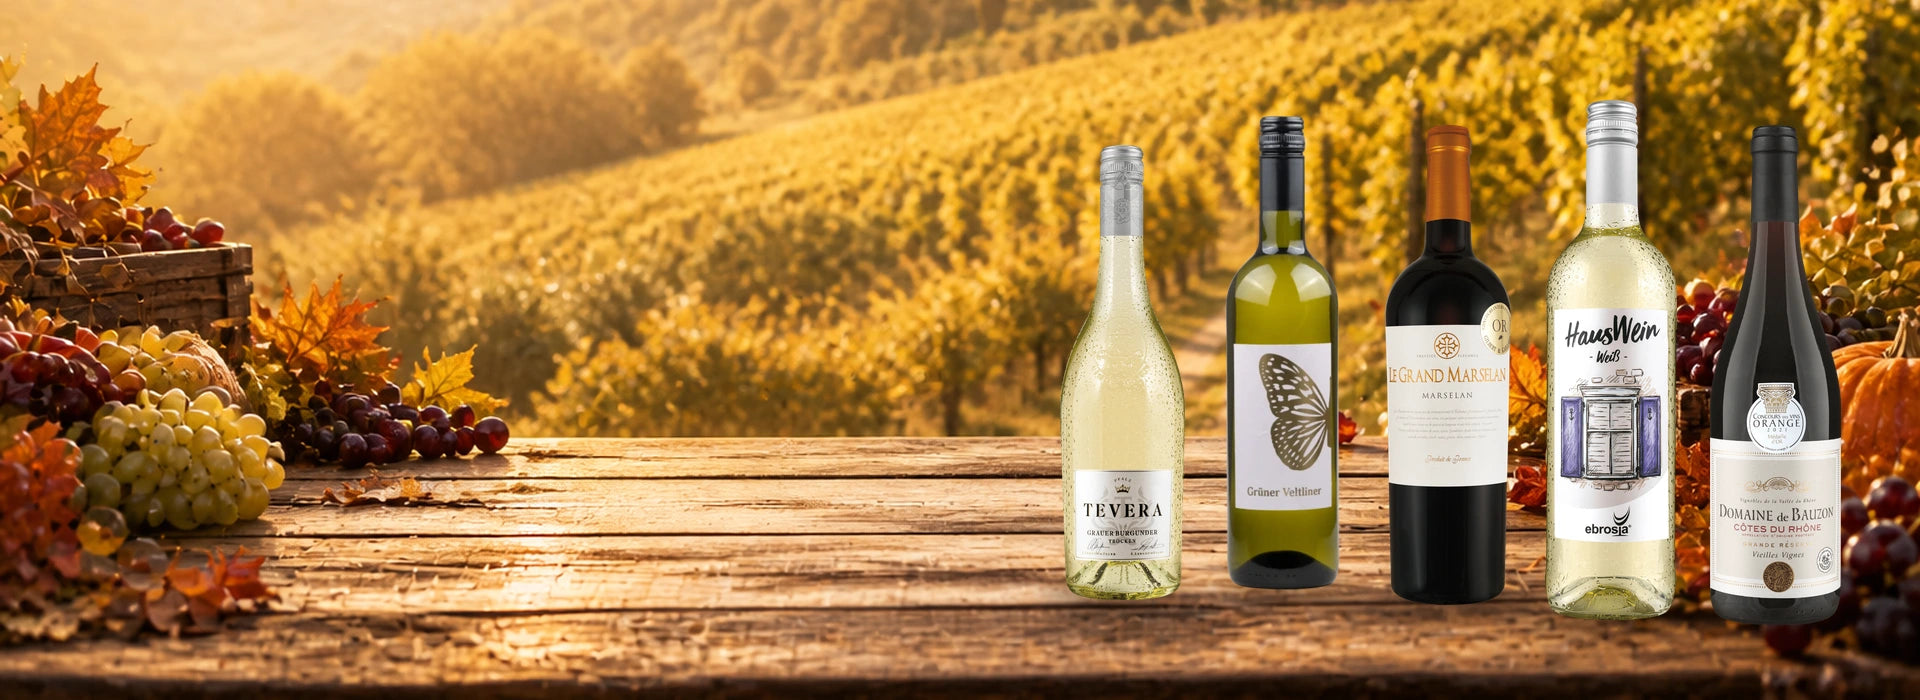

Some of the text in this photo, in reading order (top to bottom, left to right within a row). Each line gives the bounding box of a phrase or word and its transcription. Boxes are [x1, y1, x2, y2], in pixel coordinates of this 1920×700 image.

[1492, 319, 1507, 332] OR
[1565, 315, 1661, 348] HausWein
[1596, 349, 1621, 363] Weiß
[1398, 366, 1444, 383] GRAND
[1447, 366, 1506, 383] MARSELAN
[1753, 419, 1801, 428] ORANGE
[1247, 486, 1322, 497] Grüner Veltliner
[1083, 503, 1162, 517] TEVERA
[1719, 504, 1834, 521] DOMAINE de BAUZON
[1733, 523, 1767, 533] CÔTES
[1788, 523, 1822, 533] RHÔNE
[1752, 550, 1805, 560] Vieilles Vignes
